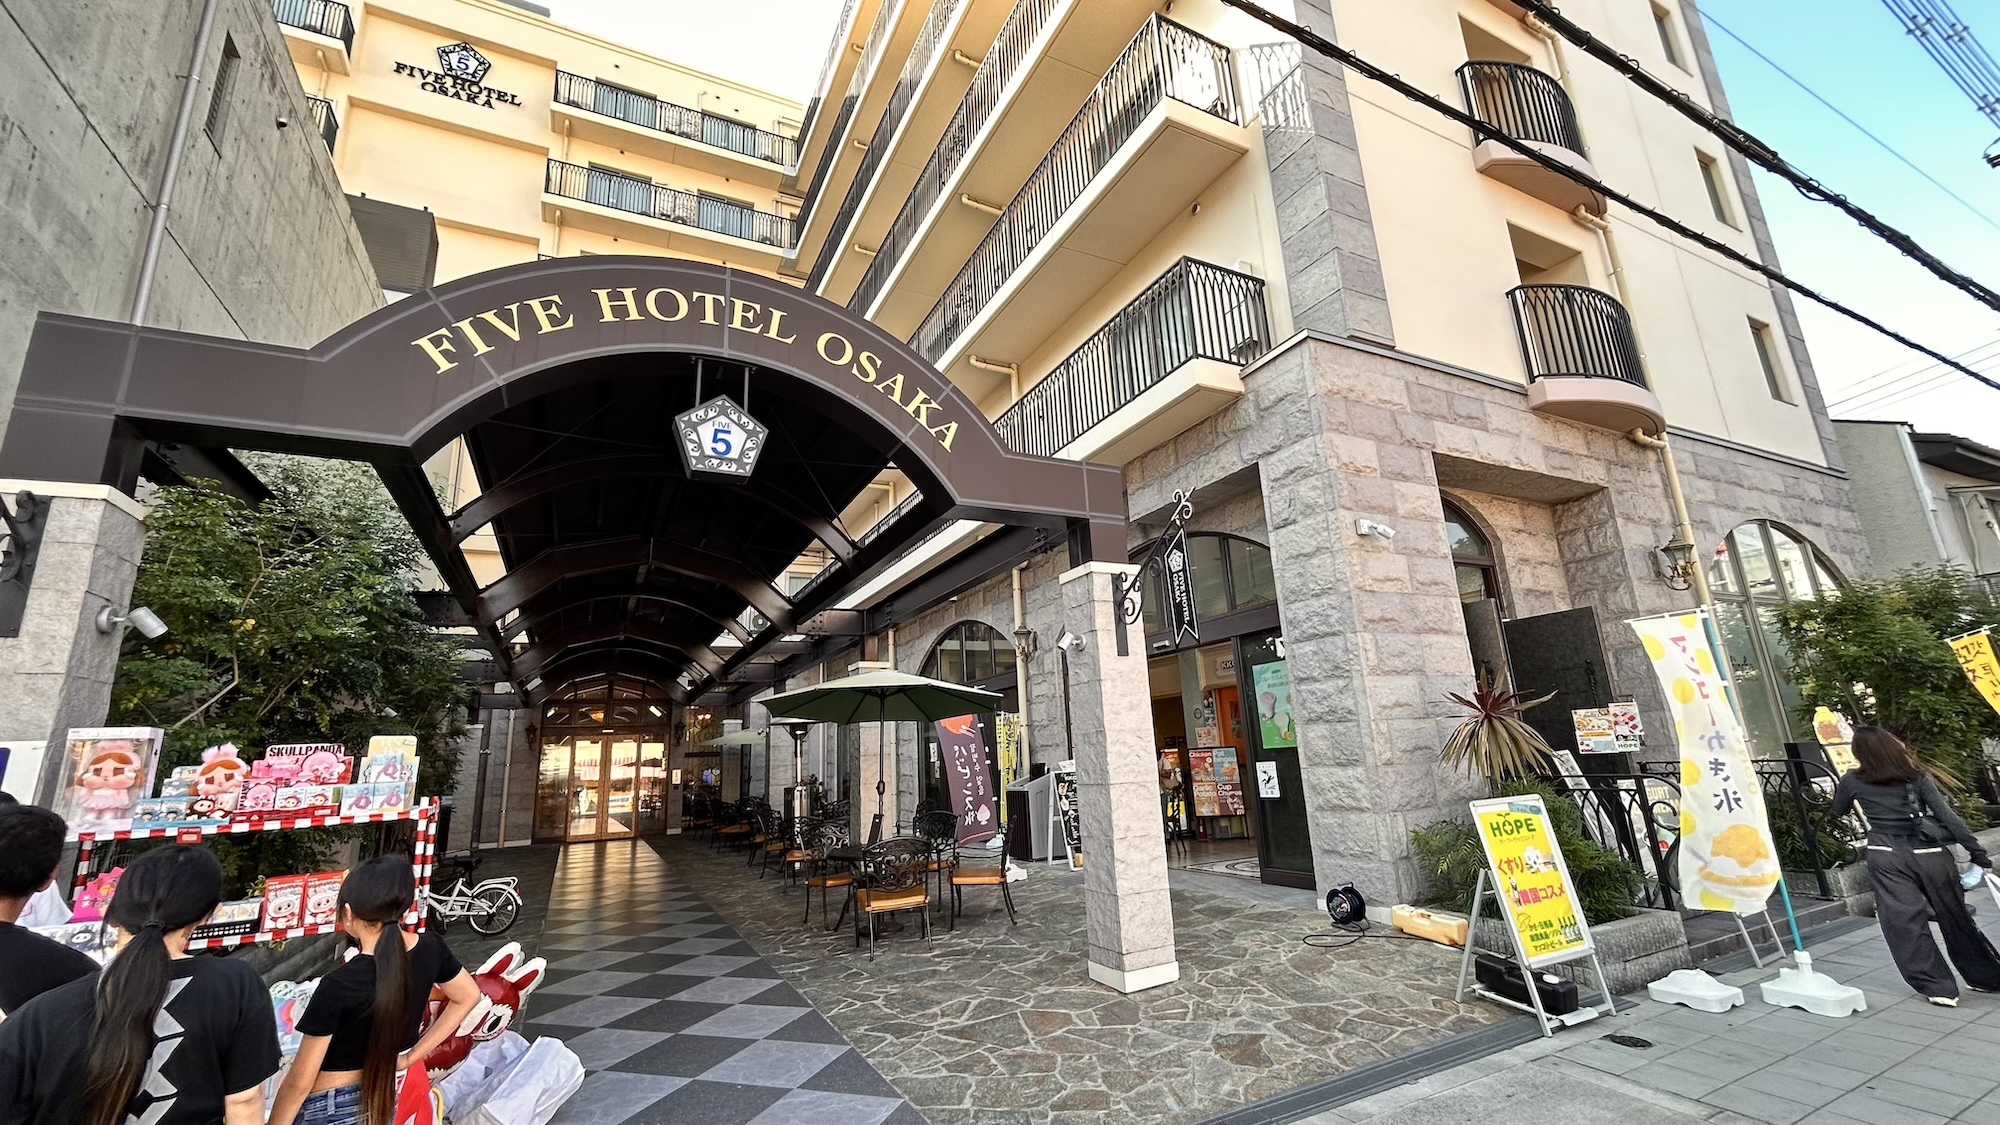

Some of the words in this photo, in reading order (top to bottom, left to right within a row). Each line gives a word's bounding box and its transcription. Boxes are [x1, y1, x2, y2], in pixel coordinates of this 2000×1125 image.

[393, 61, 446, 86] FIVE
[450, 75, 522, 107] HOTEL
[421, 81, 495, 110] OSAKA
[411, 294, 574, 375] FIVE
[591, 287, 797, 344] HOTEL
[816, 332, 959, 453] OSAKA
[712, 420, 732, 430] FIVE
[710, 429, 732, 456] 5
[1173, 572, 1181, 603] OSAKA
[1178, 571, 1186, 592] FIVE
[1181, 592, 1190, 624] HOTEL
[269, 745, 343, 757] SKULLPANDA
[1194, 790, 1217, 798] Potato
[1217, 783, 1232, 791] Cup
[1490, 818, 1536, 838] HOPE
[1497, 856, 1524, 876] くすり
